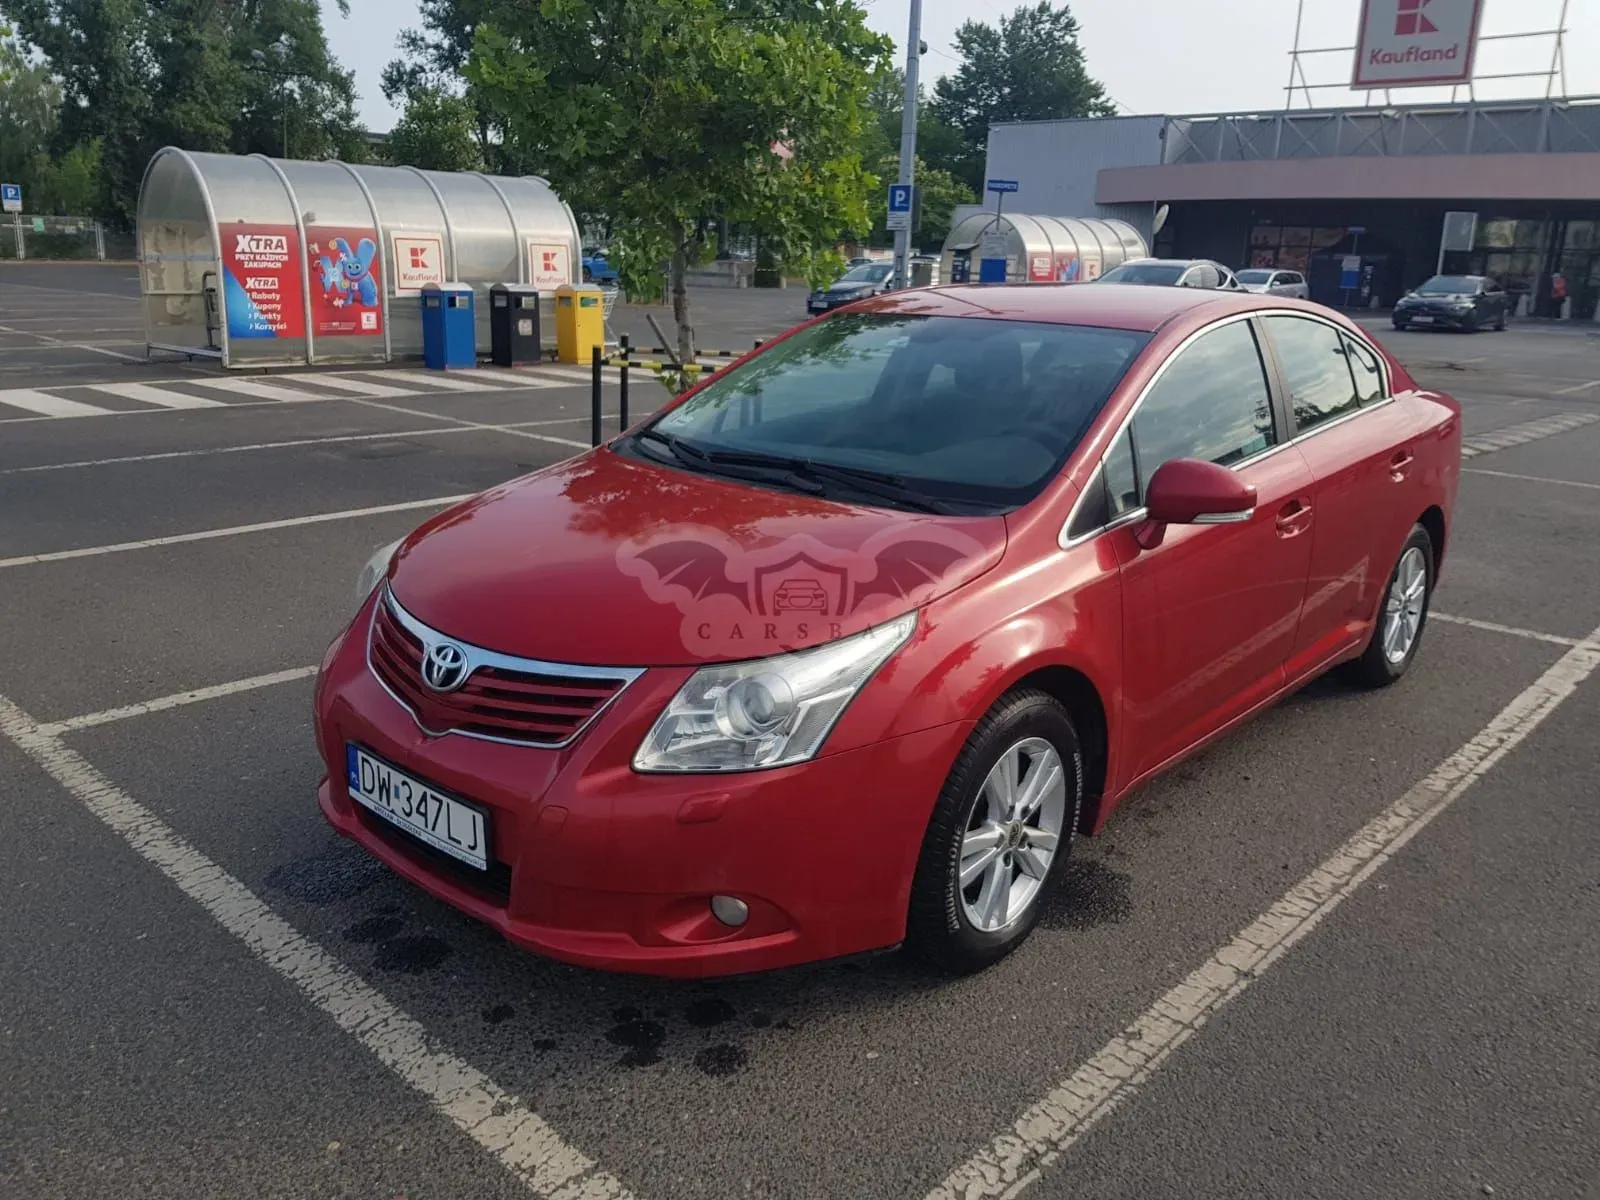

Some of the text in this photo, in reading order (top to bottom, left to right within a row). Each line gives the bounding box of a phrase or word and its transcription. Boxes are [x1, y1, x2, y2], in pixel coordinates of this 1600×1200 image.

[1369, 41, 1459, 65] Kaufland
[8, 188, 15, 199] P
[895, 189, 906, 207] P
[235, 234, 287, 253] XTRA
[235, 253, 254, 261] PRZY
[243, 261, 282, 269] ZAKUPACH
[402, 272, 439, 282] Kaufland
[536, 275, 566, 284] Kaufland
[245, 277, 278, 289] XTRA
[251, 291, 281, 301] Raboty
[252, 302, 282, 311] Kupony
[253, 312, 281, 321] Punkty
[401, 780, 478, 851] 347LJ
[943, 823, 962, 934] BRIDGESTONE
